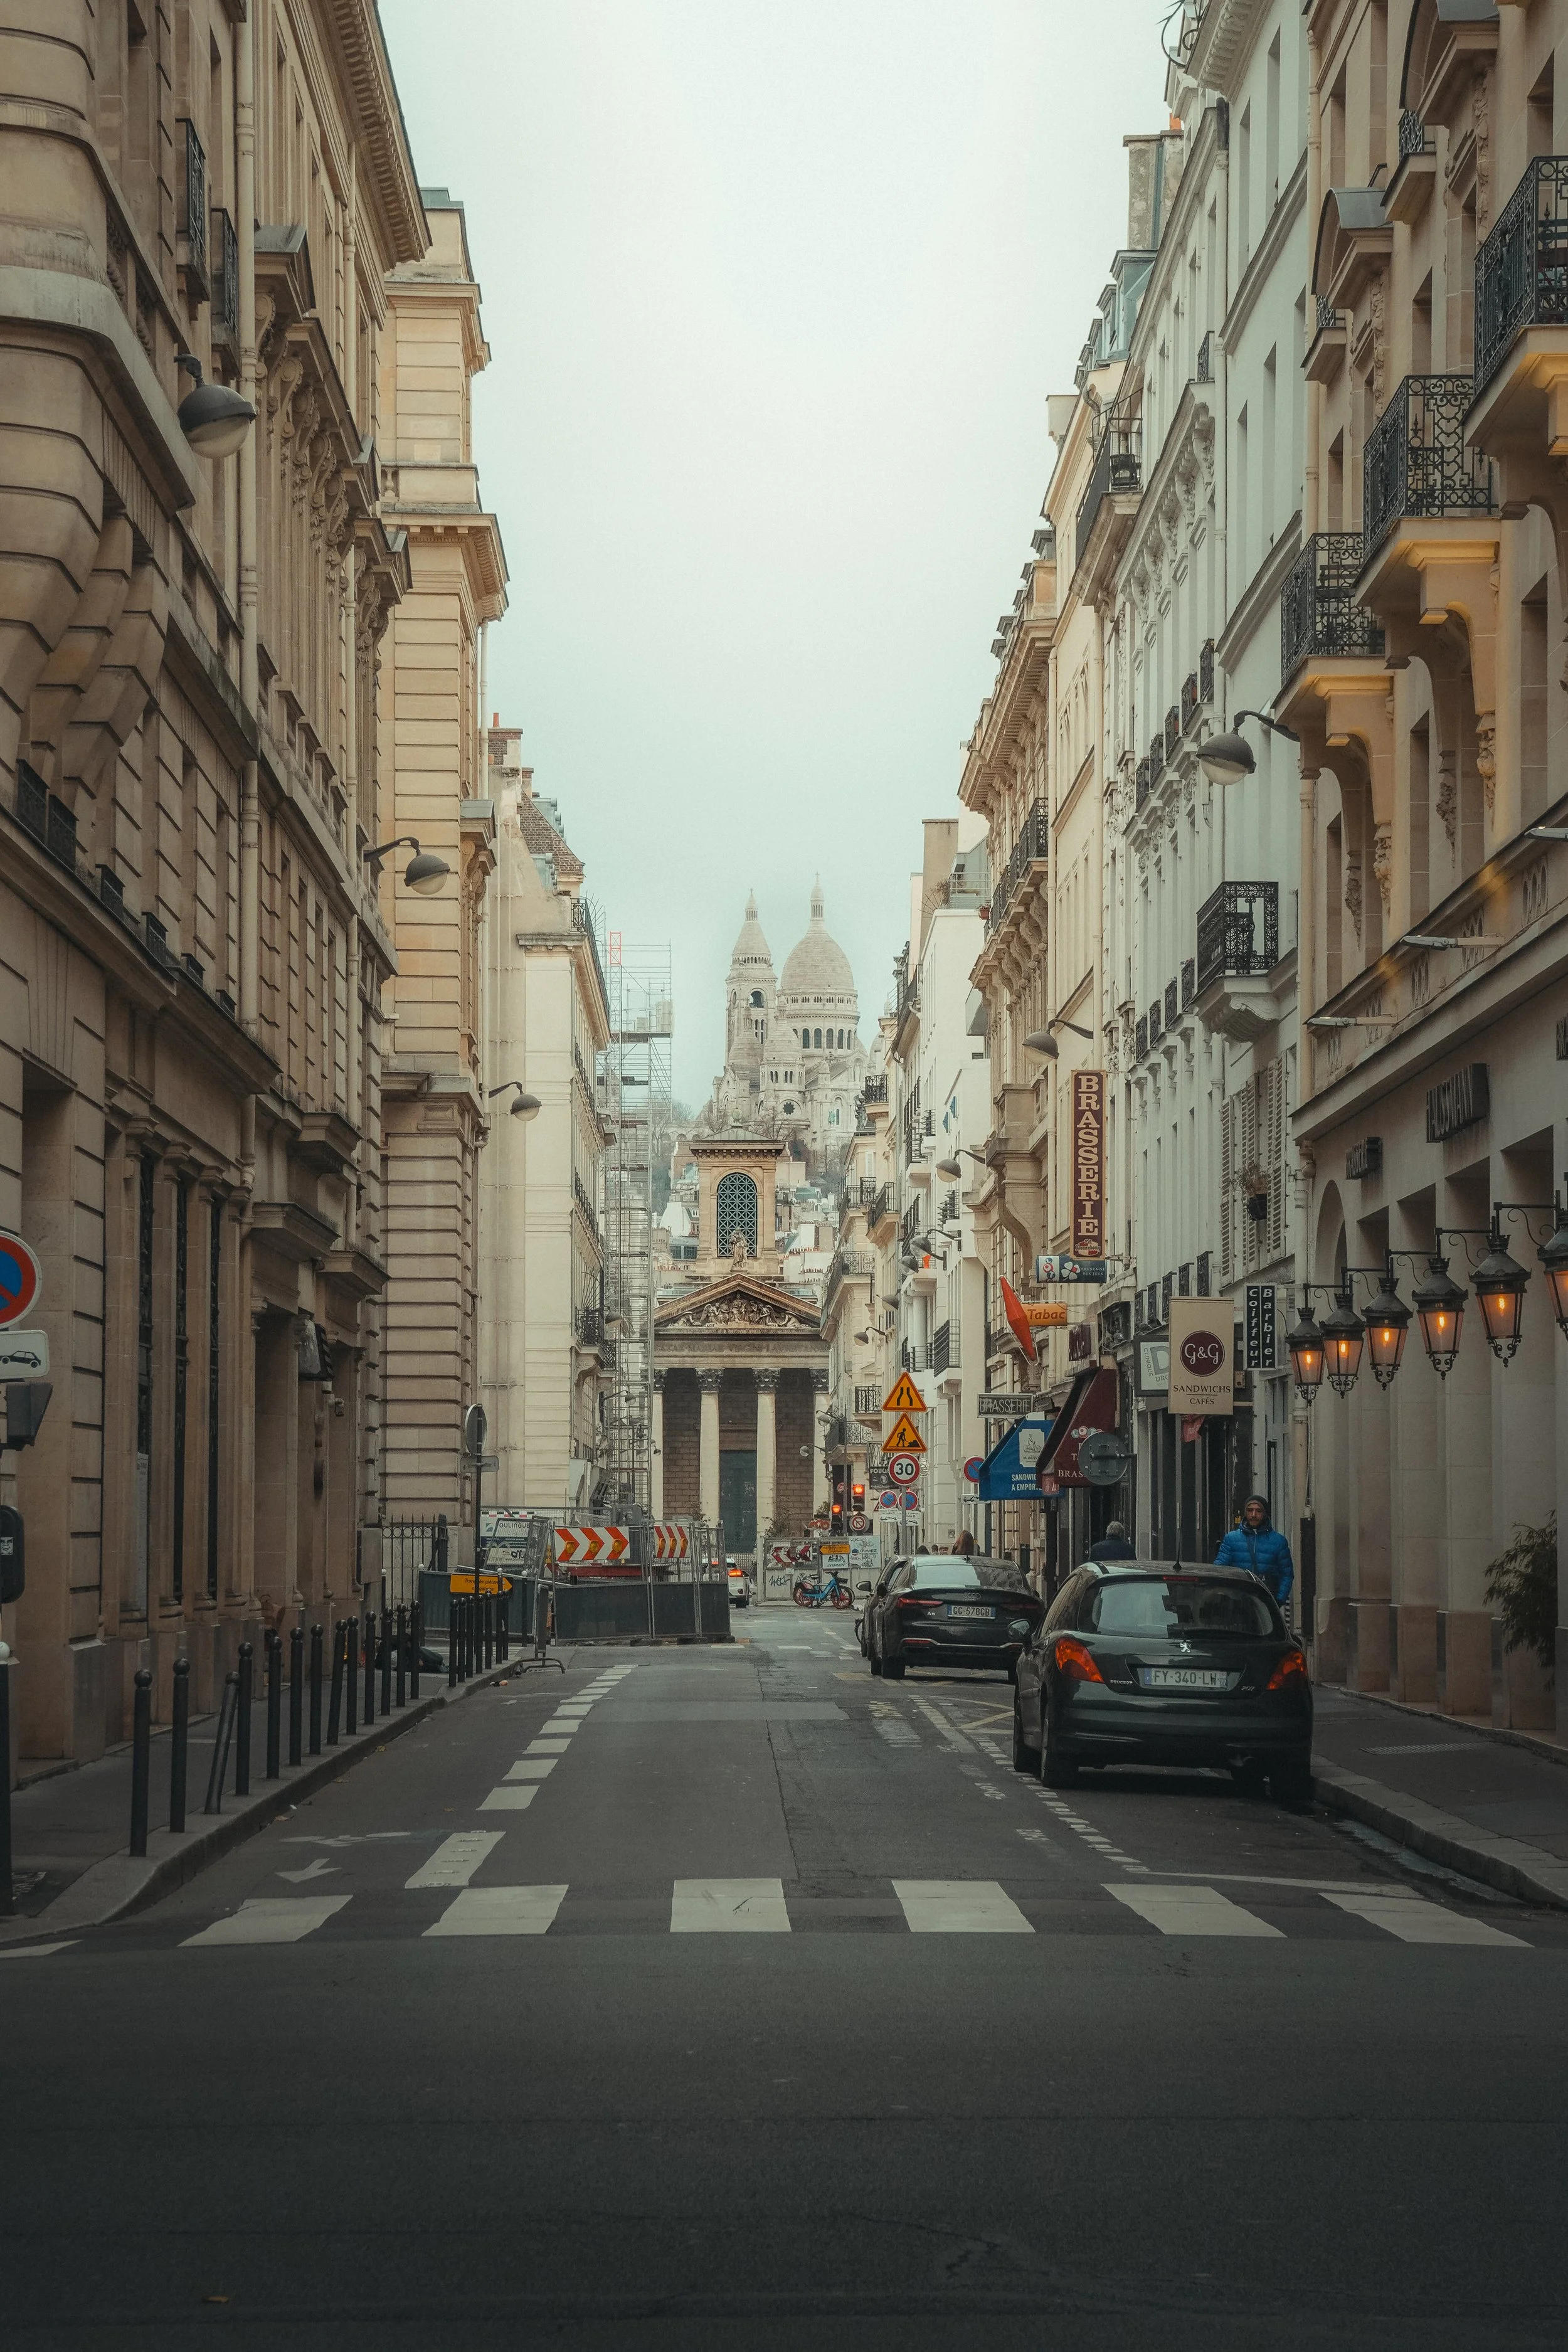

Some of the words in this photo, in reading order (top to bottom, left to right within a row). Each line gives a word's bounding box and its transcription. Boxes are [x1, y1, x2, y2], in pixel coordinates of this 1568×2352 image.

[1077, 1075, 1100, 1236] BRASSERIE
[1027, 1309, 1065, 1319] Tabac
[1249, 1289, 1258, 1366] Coiffeur
[1263, 1289, 1273, 1367] Barbier
[1184, 1343, 1219, 1365] G&G
[1144, 1348, 1153, 1377] CLINIQUE
[1173, 1384, 1231, 1393] SANDWICHS
[979, 1399, 1030, 1412] BRASSERIE
[1190, 1397, 1214, 1405] CAFÉS
[896, 1463, 914, 1475] 30
[1058, 1470, 1084, 1478] BRAS
